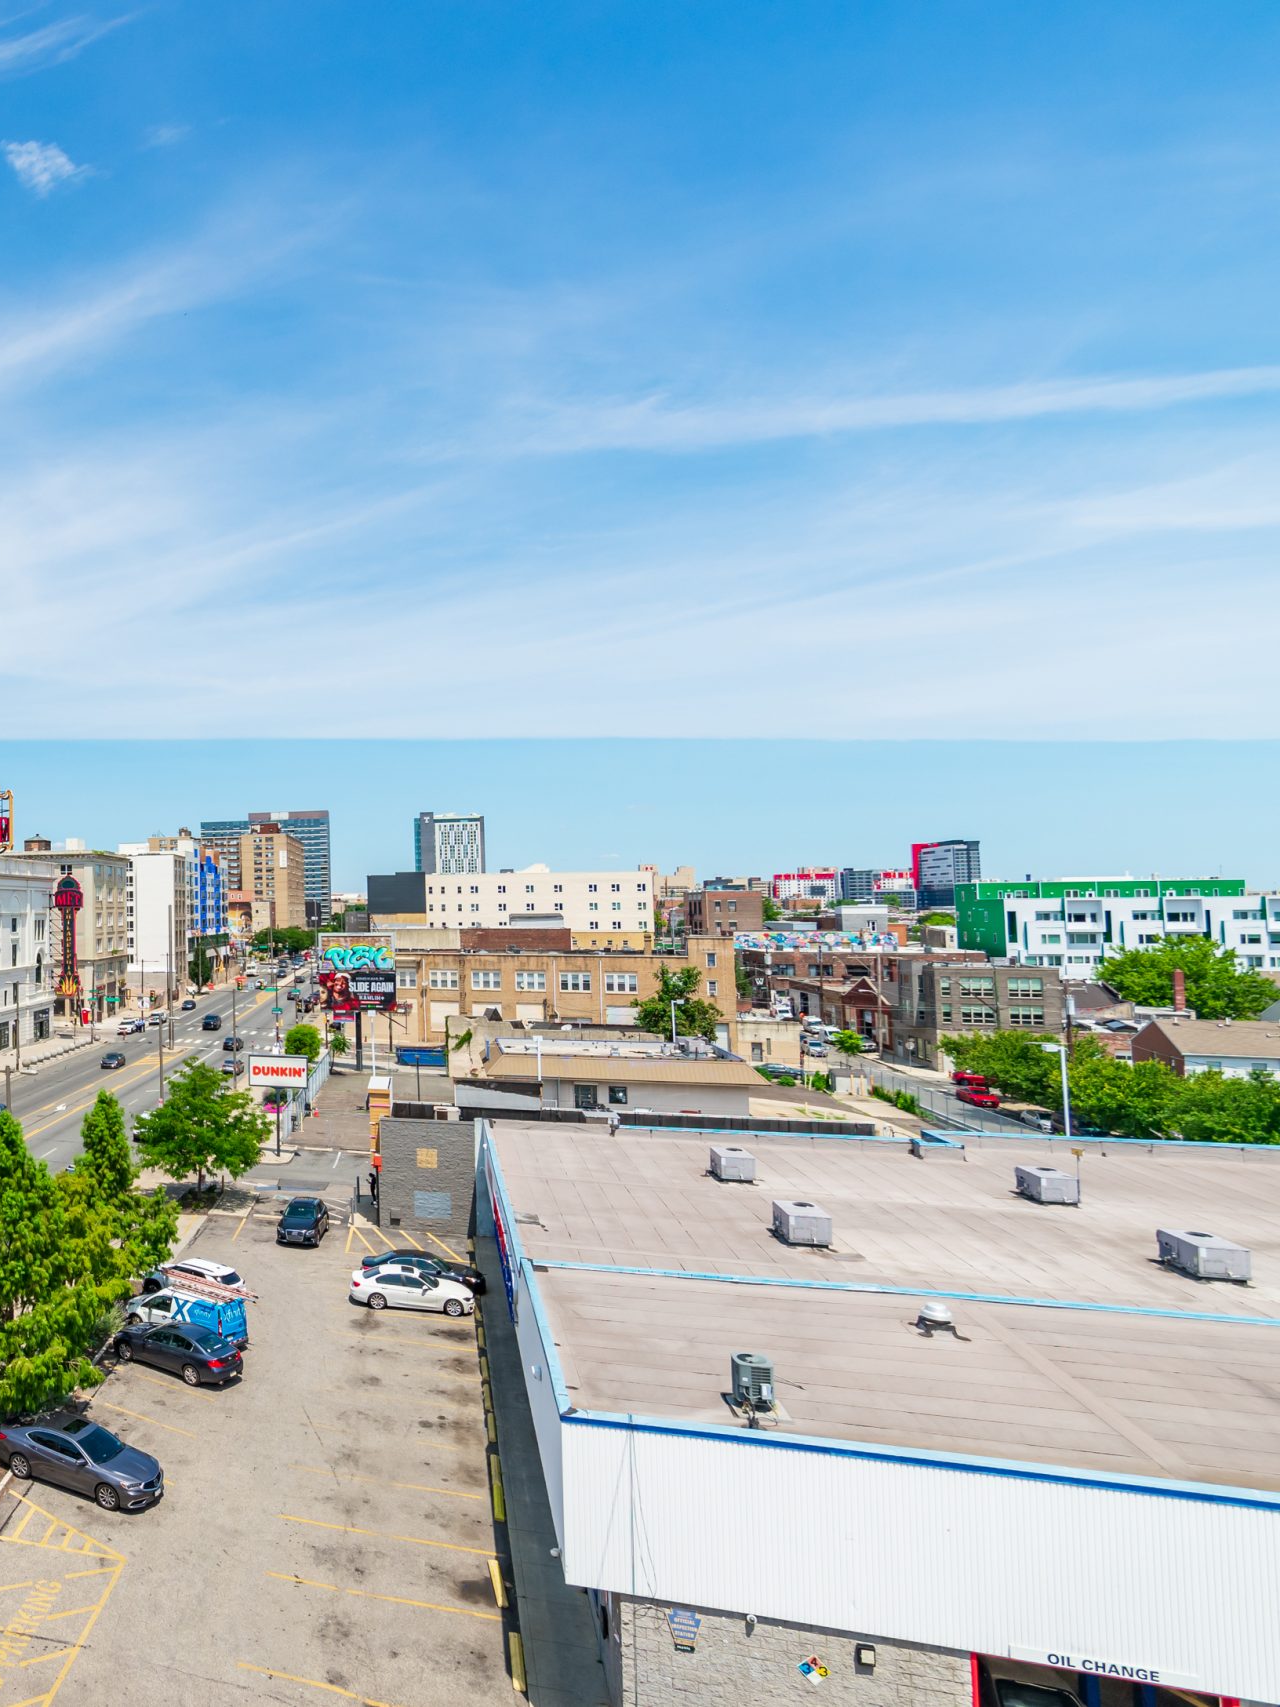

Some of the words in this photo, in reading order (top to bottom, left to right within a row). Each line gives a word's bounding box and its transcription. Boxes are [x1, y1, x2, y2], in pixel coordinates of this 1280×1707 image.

[57, 891, 81, 906] MET
[349, 982, 370, 993] SLIDE
[371, 982, 395, 993] AGAIN
[252, 1065, 306, 1078] DUNKIN'
[673, 1617, 695, 1625] OFFICIAL
[674, 1630, 695, 1638] STATION
[810, 1656, 819, 1667] 4
[801, 1662, 811, 1674] 3
[819, 1666, 828, 1677] 3
[1047, 1653, 1076, 1668] OIL
[1081, 1659, 1160, 1682] CHANGE
